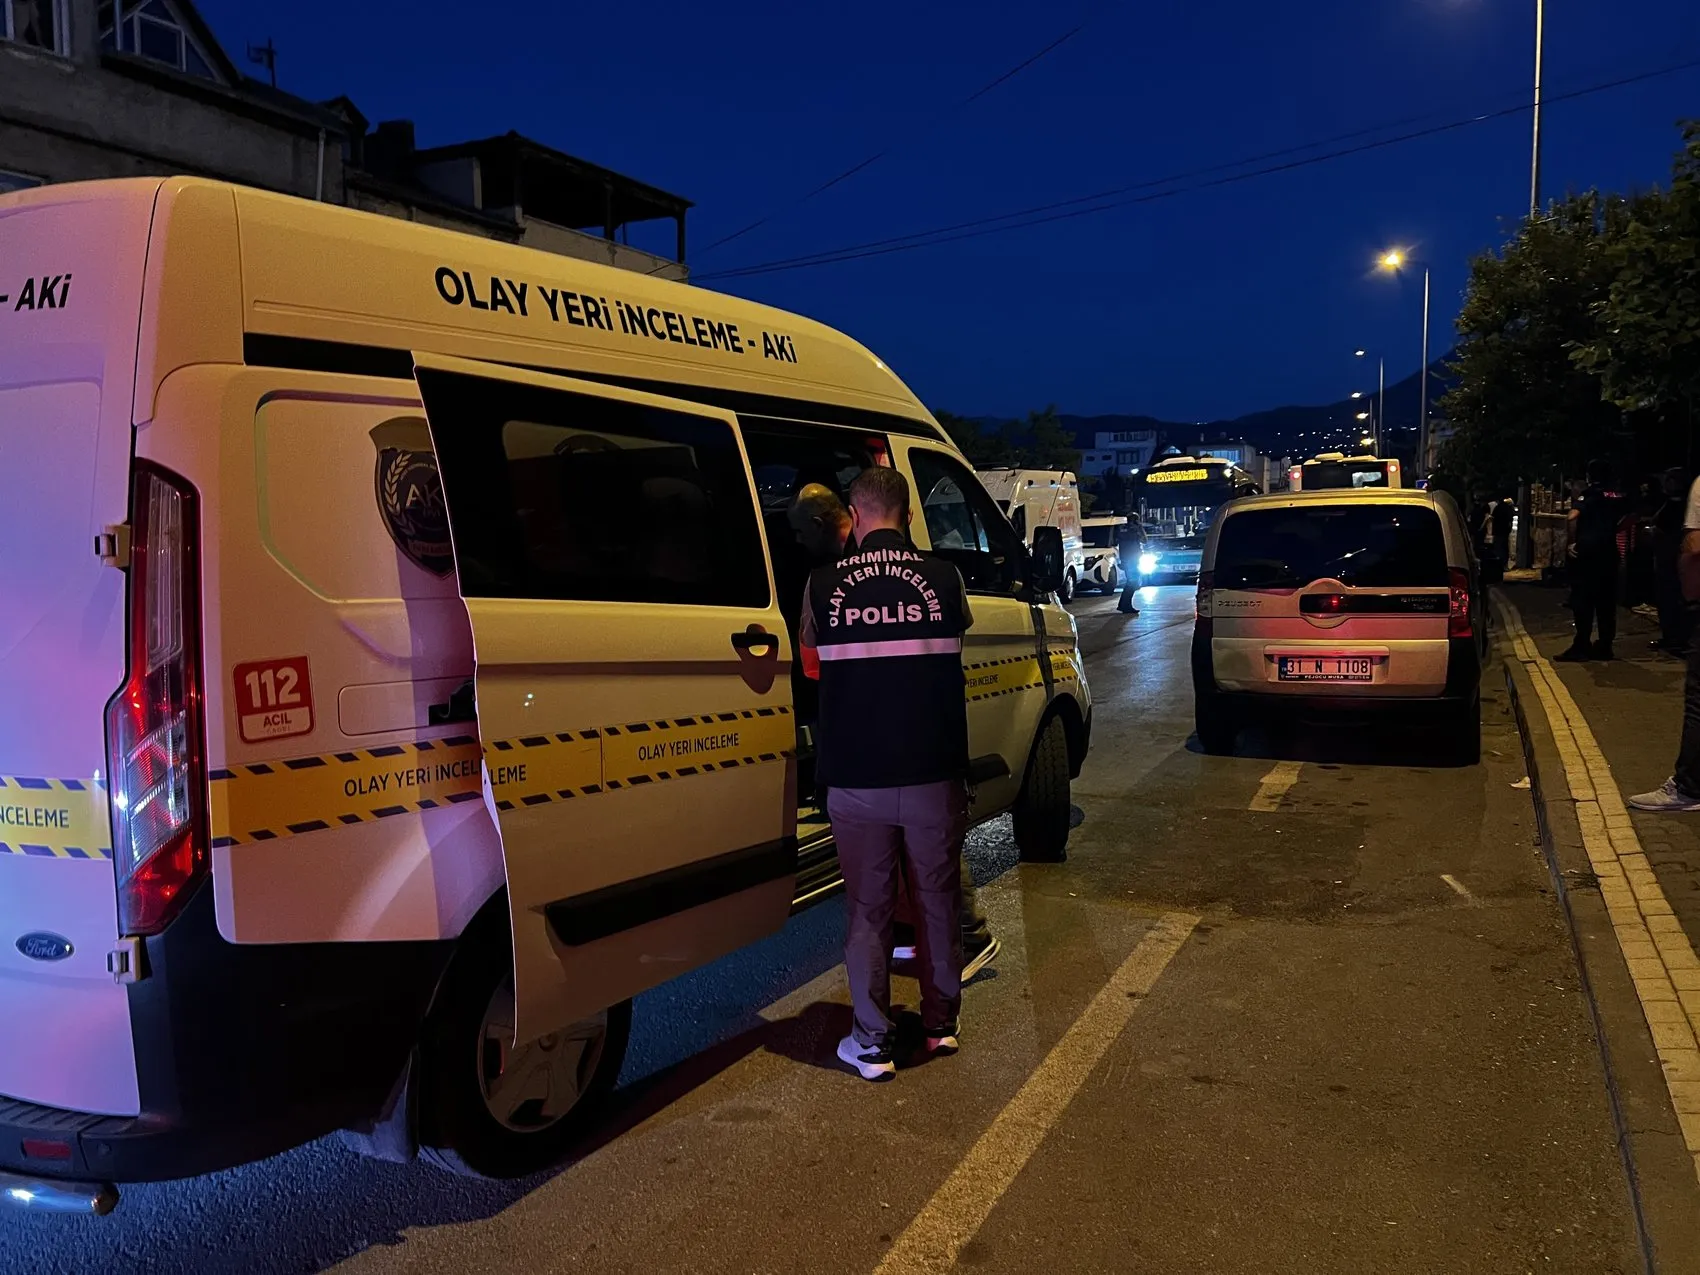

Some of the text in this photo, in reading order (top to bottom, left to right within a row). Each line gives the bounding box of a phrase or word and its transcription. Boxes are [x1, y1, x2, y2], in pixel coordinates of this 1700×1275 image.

[434, 266, 529, 317] OLAY
[829, 587, 846, 627] OLAY
[1287, 660, 1369, 673] 31 N 1108
[245, 666, 301, 709] 112
[638, 743, 666, 761] OLAY
[344, 773, 390, 797] OLAY
[26, 937, 57, 957] Ford
